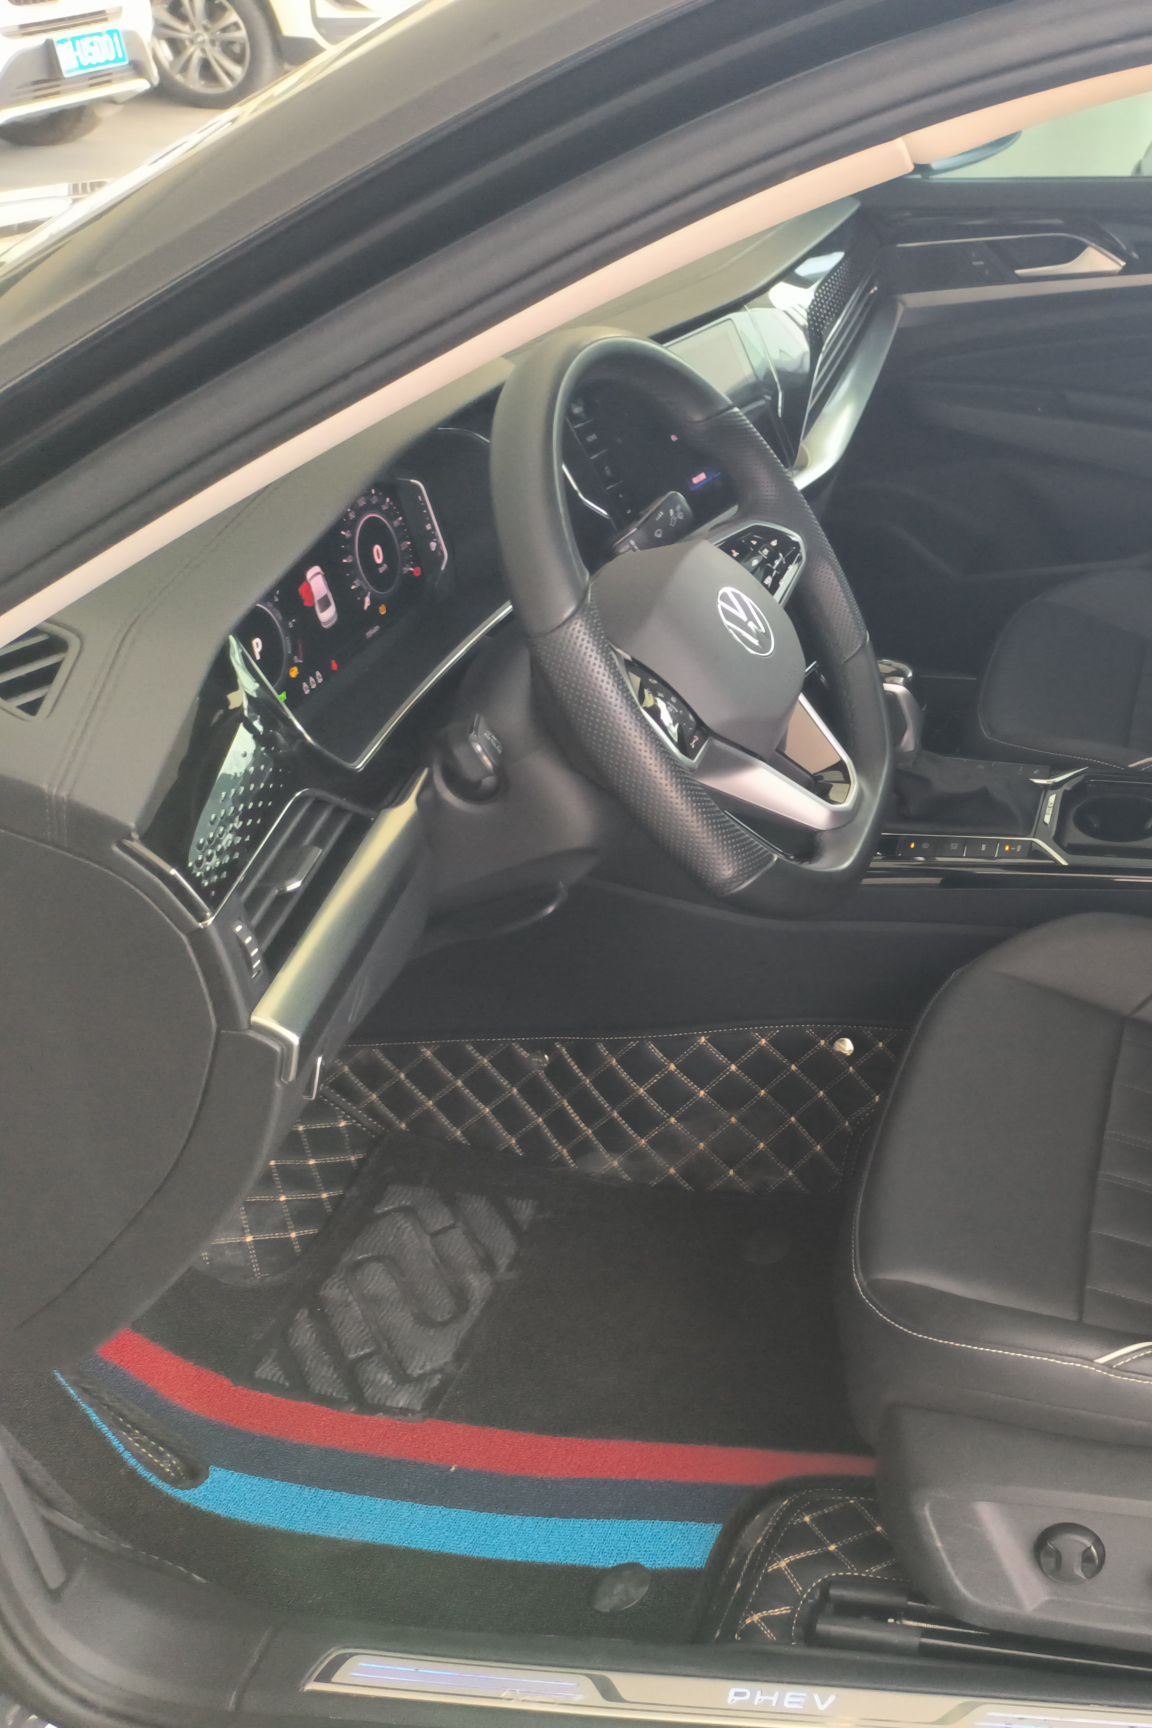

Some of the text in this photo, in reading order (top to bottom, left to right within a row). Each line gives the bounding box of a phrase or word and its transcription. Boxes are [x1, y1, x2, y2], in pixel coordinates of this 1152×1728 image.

[372, 544, 384, 565] 0
[251, 637, 263, 661] P
[727, 1687, 837, 1711] PHEV
